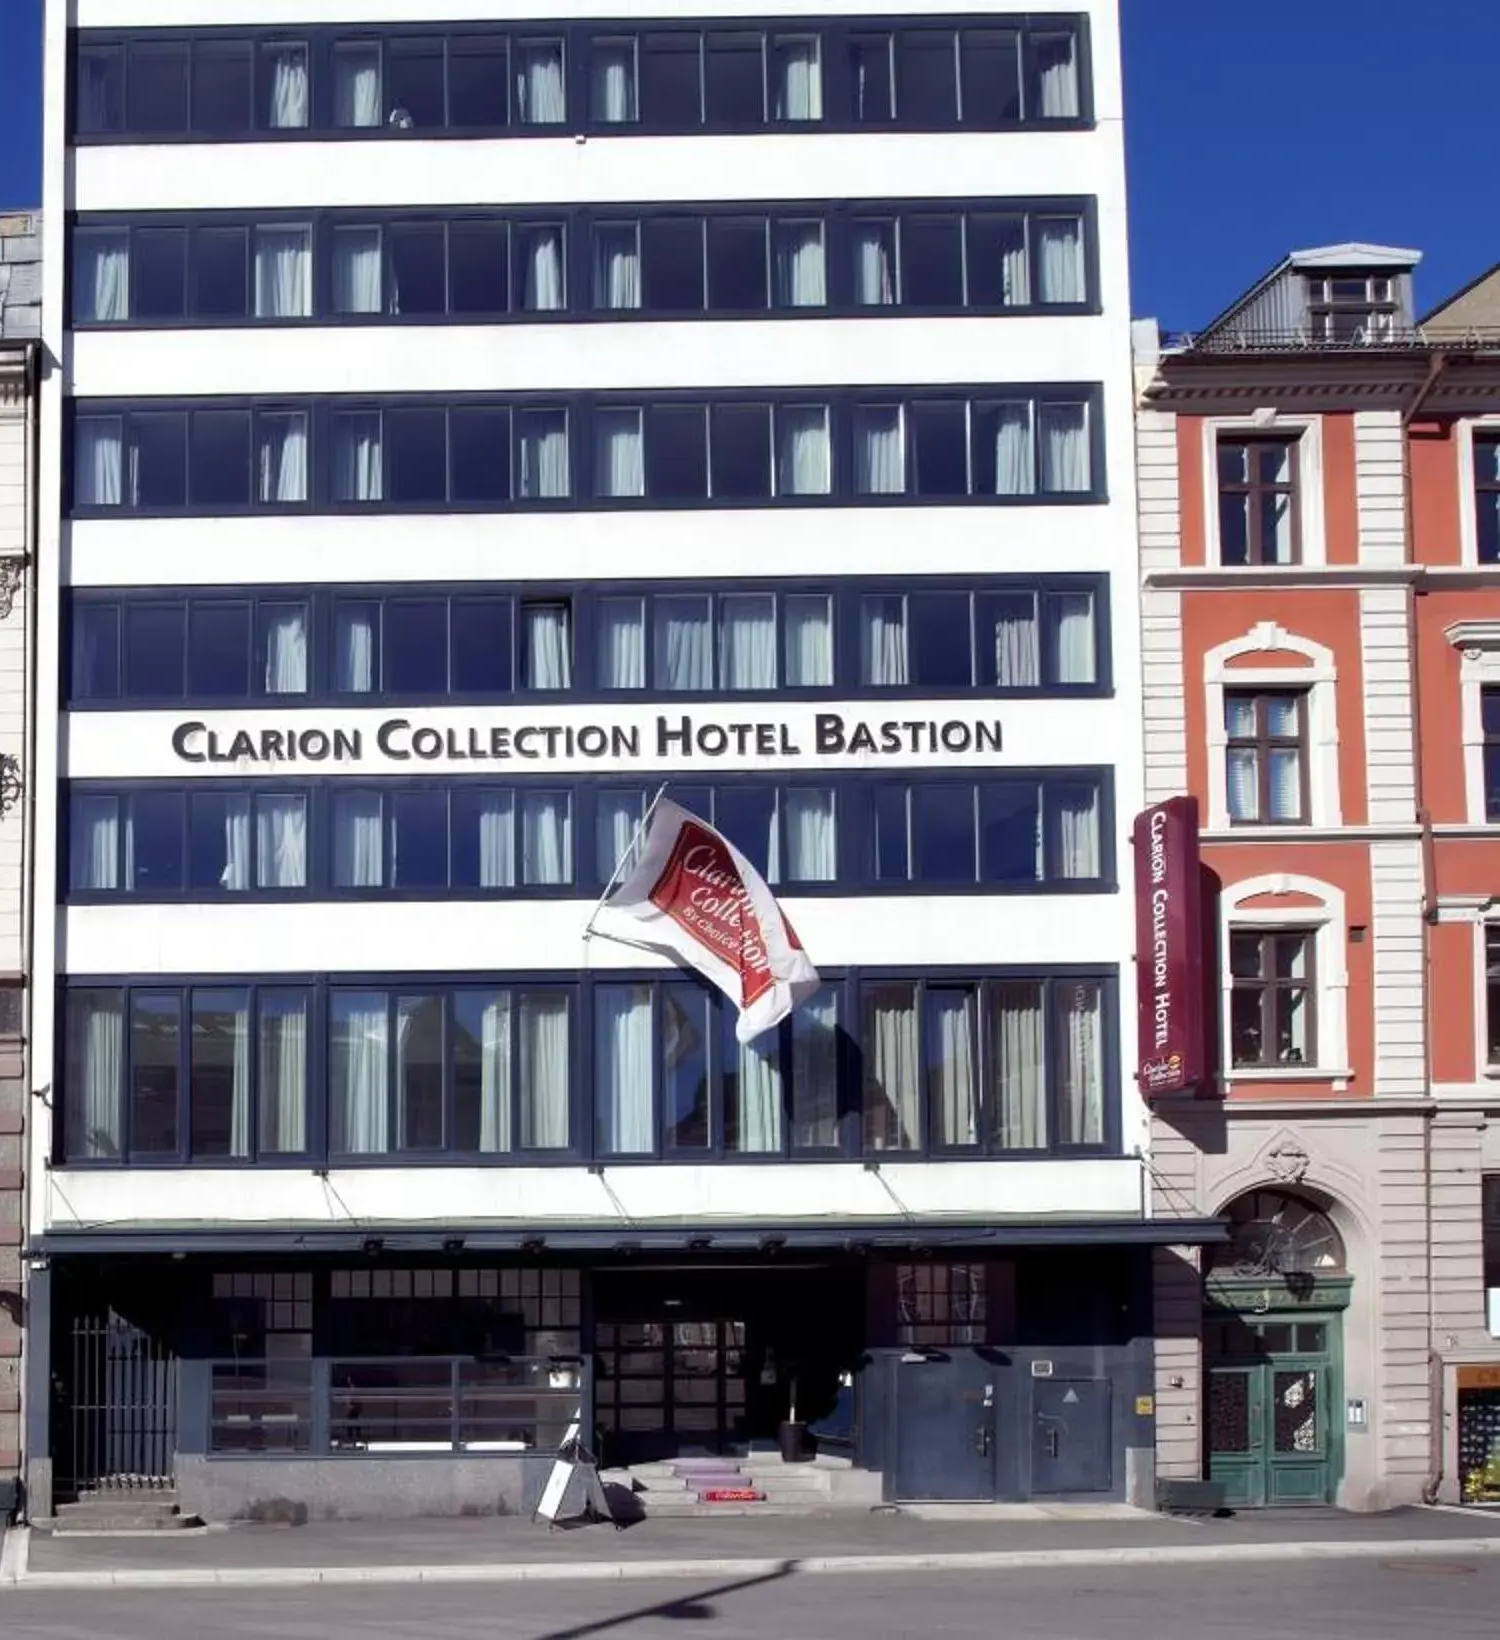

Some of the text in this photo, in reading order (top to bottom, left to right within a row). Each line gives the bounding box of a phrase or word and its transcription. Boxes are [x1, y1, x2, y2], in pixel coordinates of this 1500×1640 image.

[171, 713, 1003, 763] CLARION COLLECTION HOTEL BASTION
[1150, 811, 1167, 884] CLARION
[1153, 889, 1169, 987] COLLECTION
[1155, 993, 1170, 1049] HOTEL
